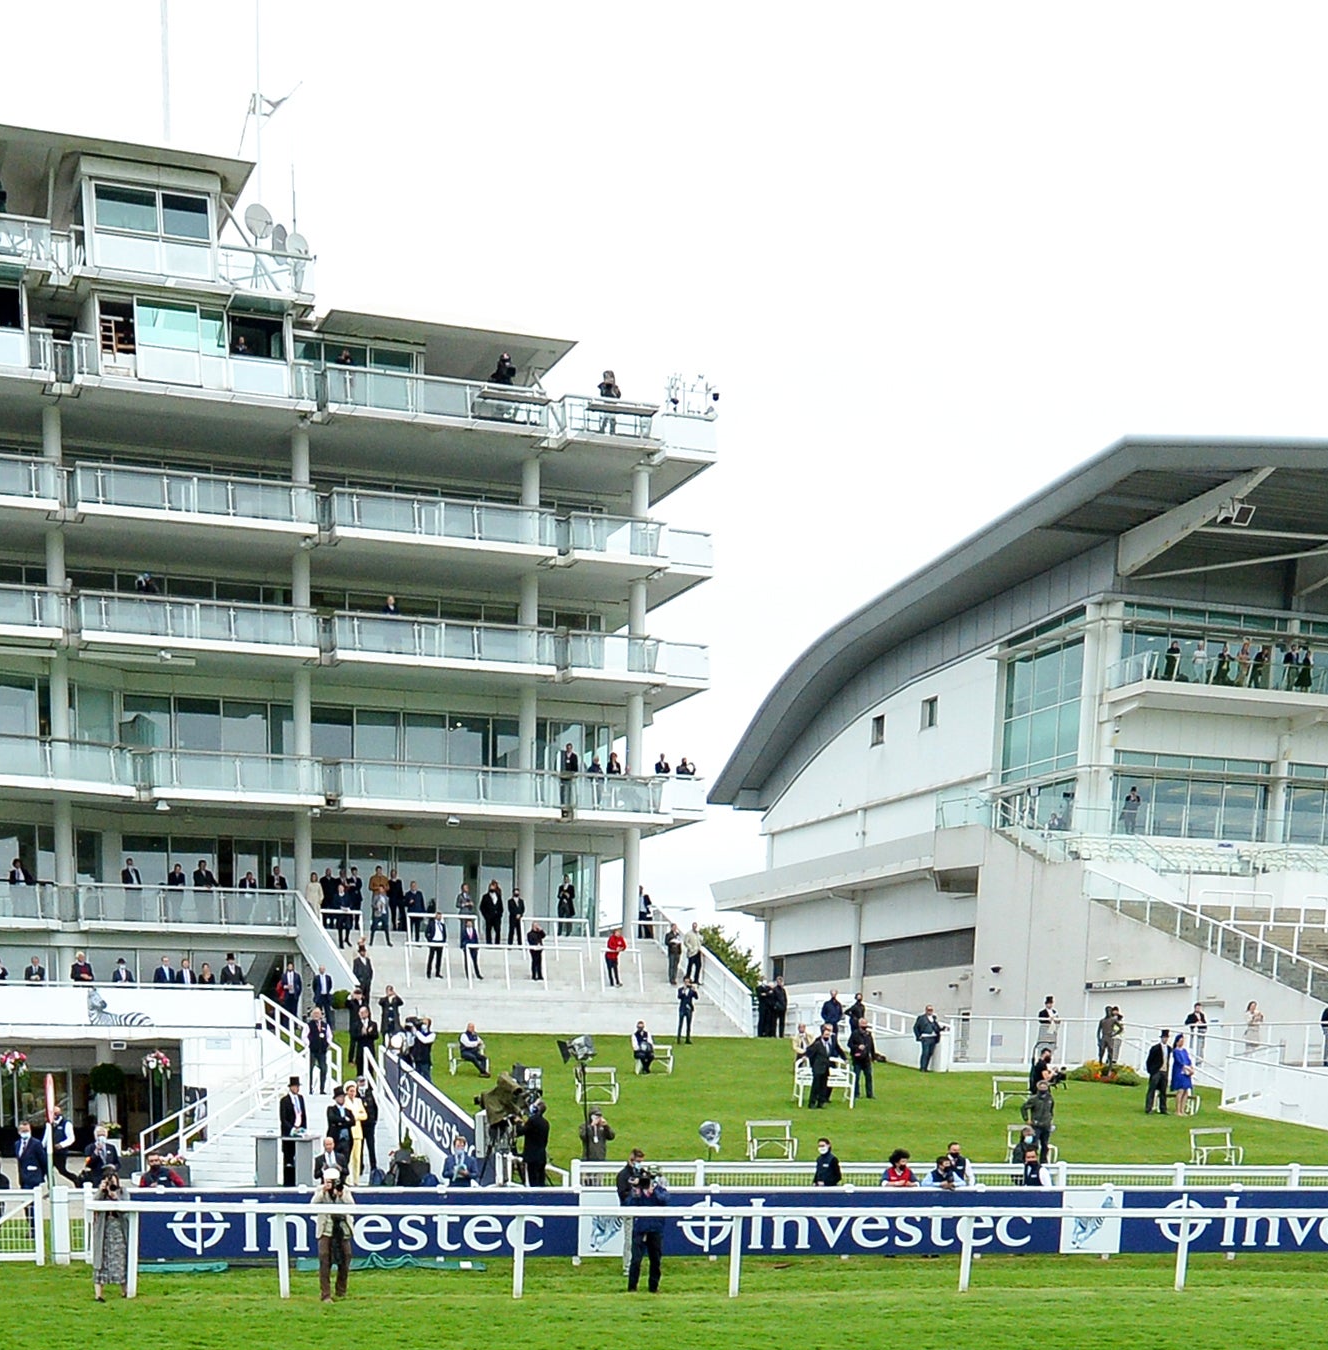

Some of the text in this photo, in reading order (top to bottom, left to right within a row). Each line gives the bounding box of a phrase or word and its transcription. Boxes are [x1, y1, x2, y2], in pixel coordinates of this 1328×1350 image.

[410, 1082, 475, 1157] Invest
[242, 1198, 544, 1252] Inestec
[747, 1198, 1033, 1250] Investec
